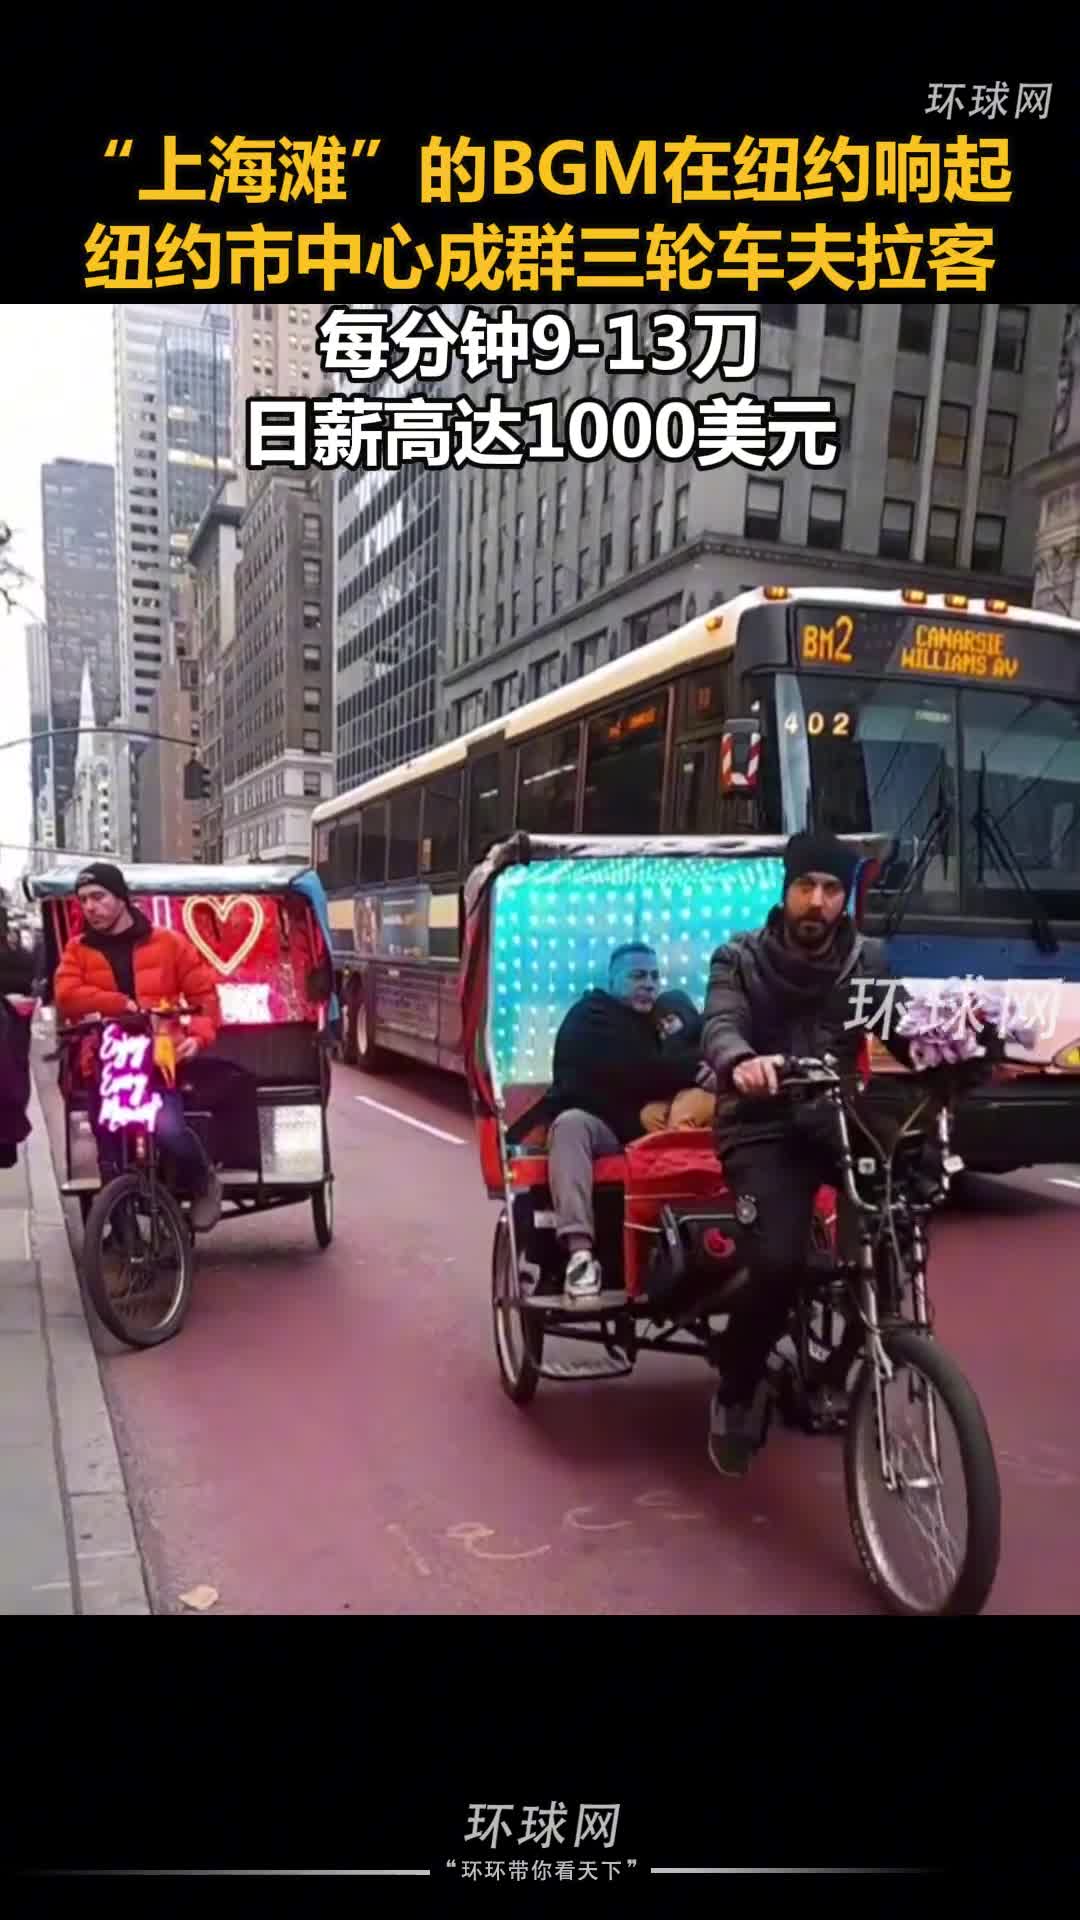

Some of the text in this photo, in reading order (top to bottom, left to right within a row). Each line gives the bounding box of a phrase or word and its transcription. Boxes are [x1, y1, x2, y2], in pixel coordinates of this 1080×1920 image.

[802, 614, 854, 664] BM2
[915, 623, 1005, 654] CANARSIE
[901, 647, 1019, 680] WILLIAMS AV
[783, 711, 850, 736] 402
